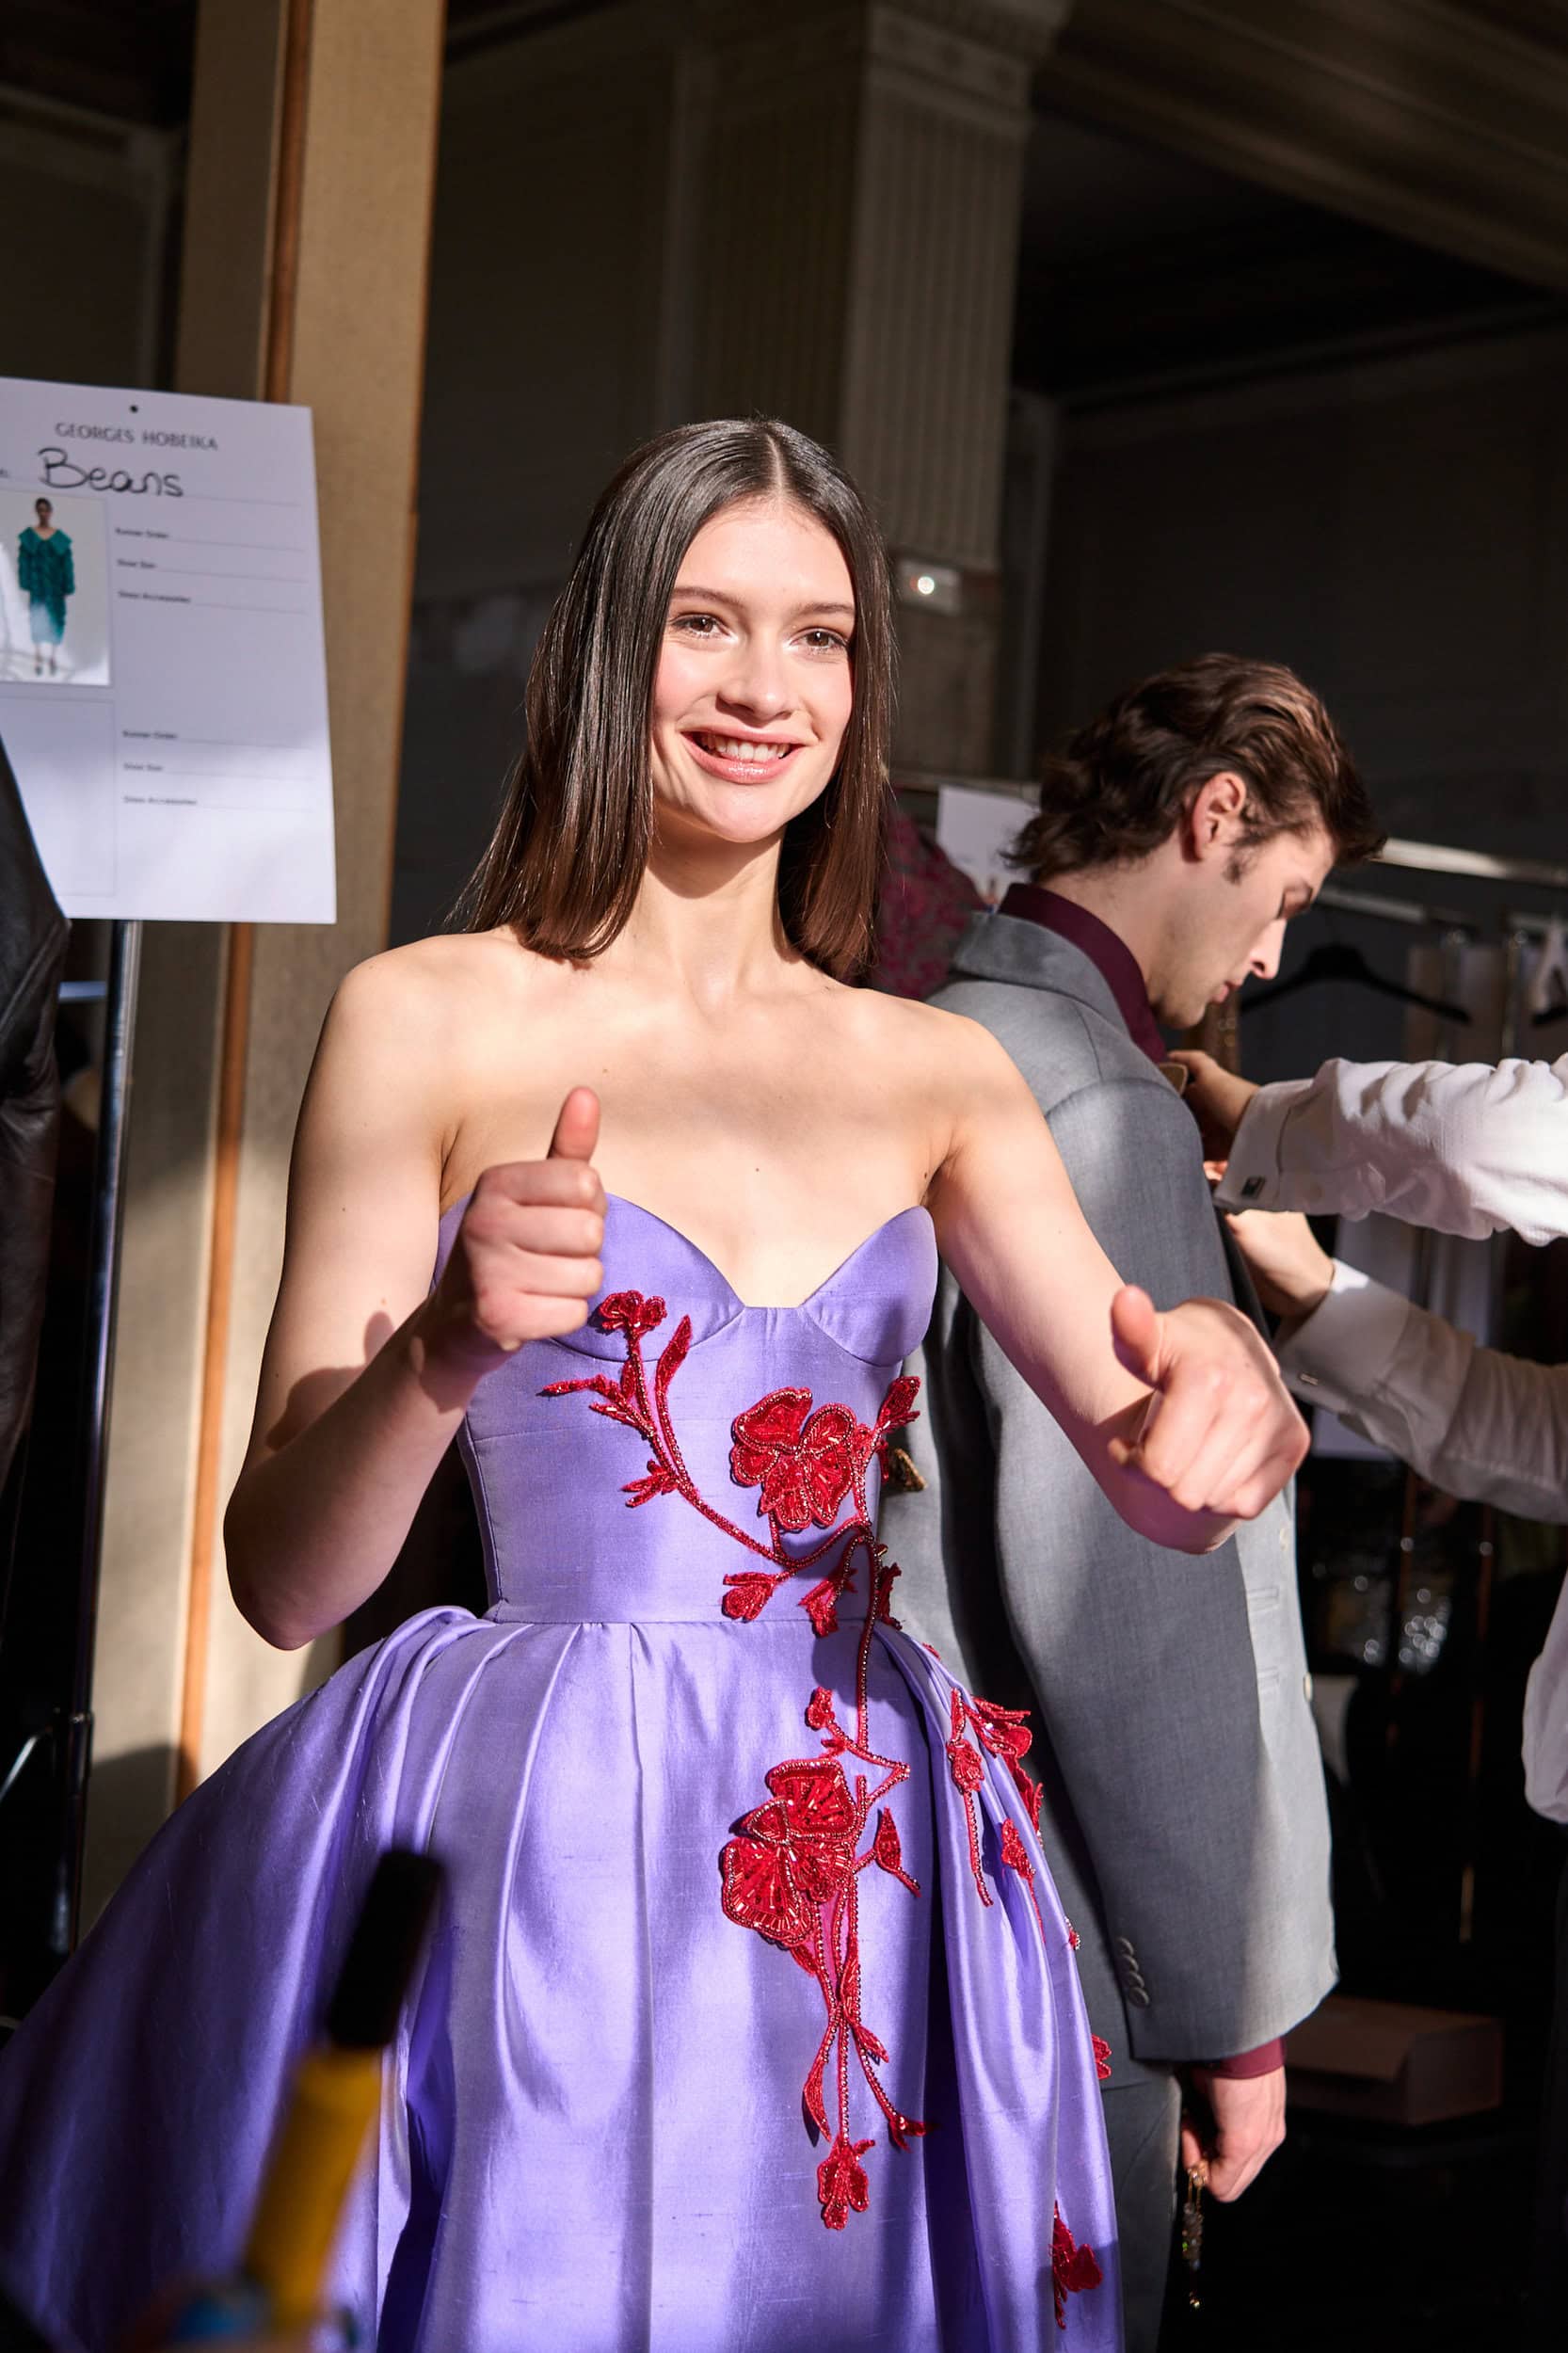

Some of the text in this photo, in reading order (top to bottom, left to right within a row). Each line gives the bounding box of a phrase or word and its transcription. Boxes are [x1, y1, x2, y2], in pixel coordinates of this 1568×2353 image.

[55, 423, 218, 450] GEORGES HOBEIKA
[38, 447, 184, 497] Beans
